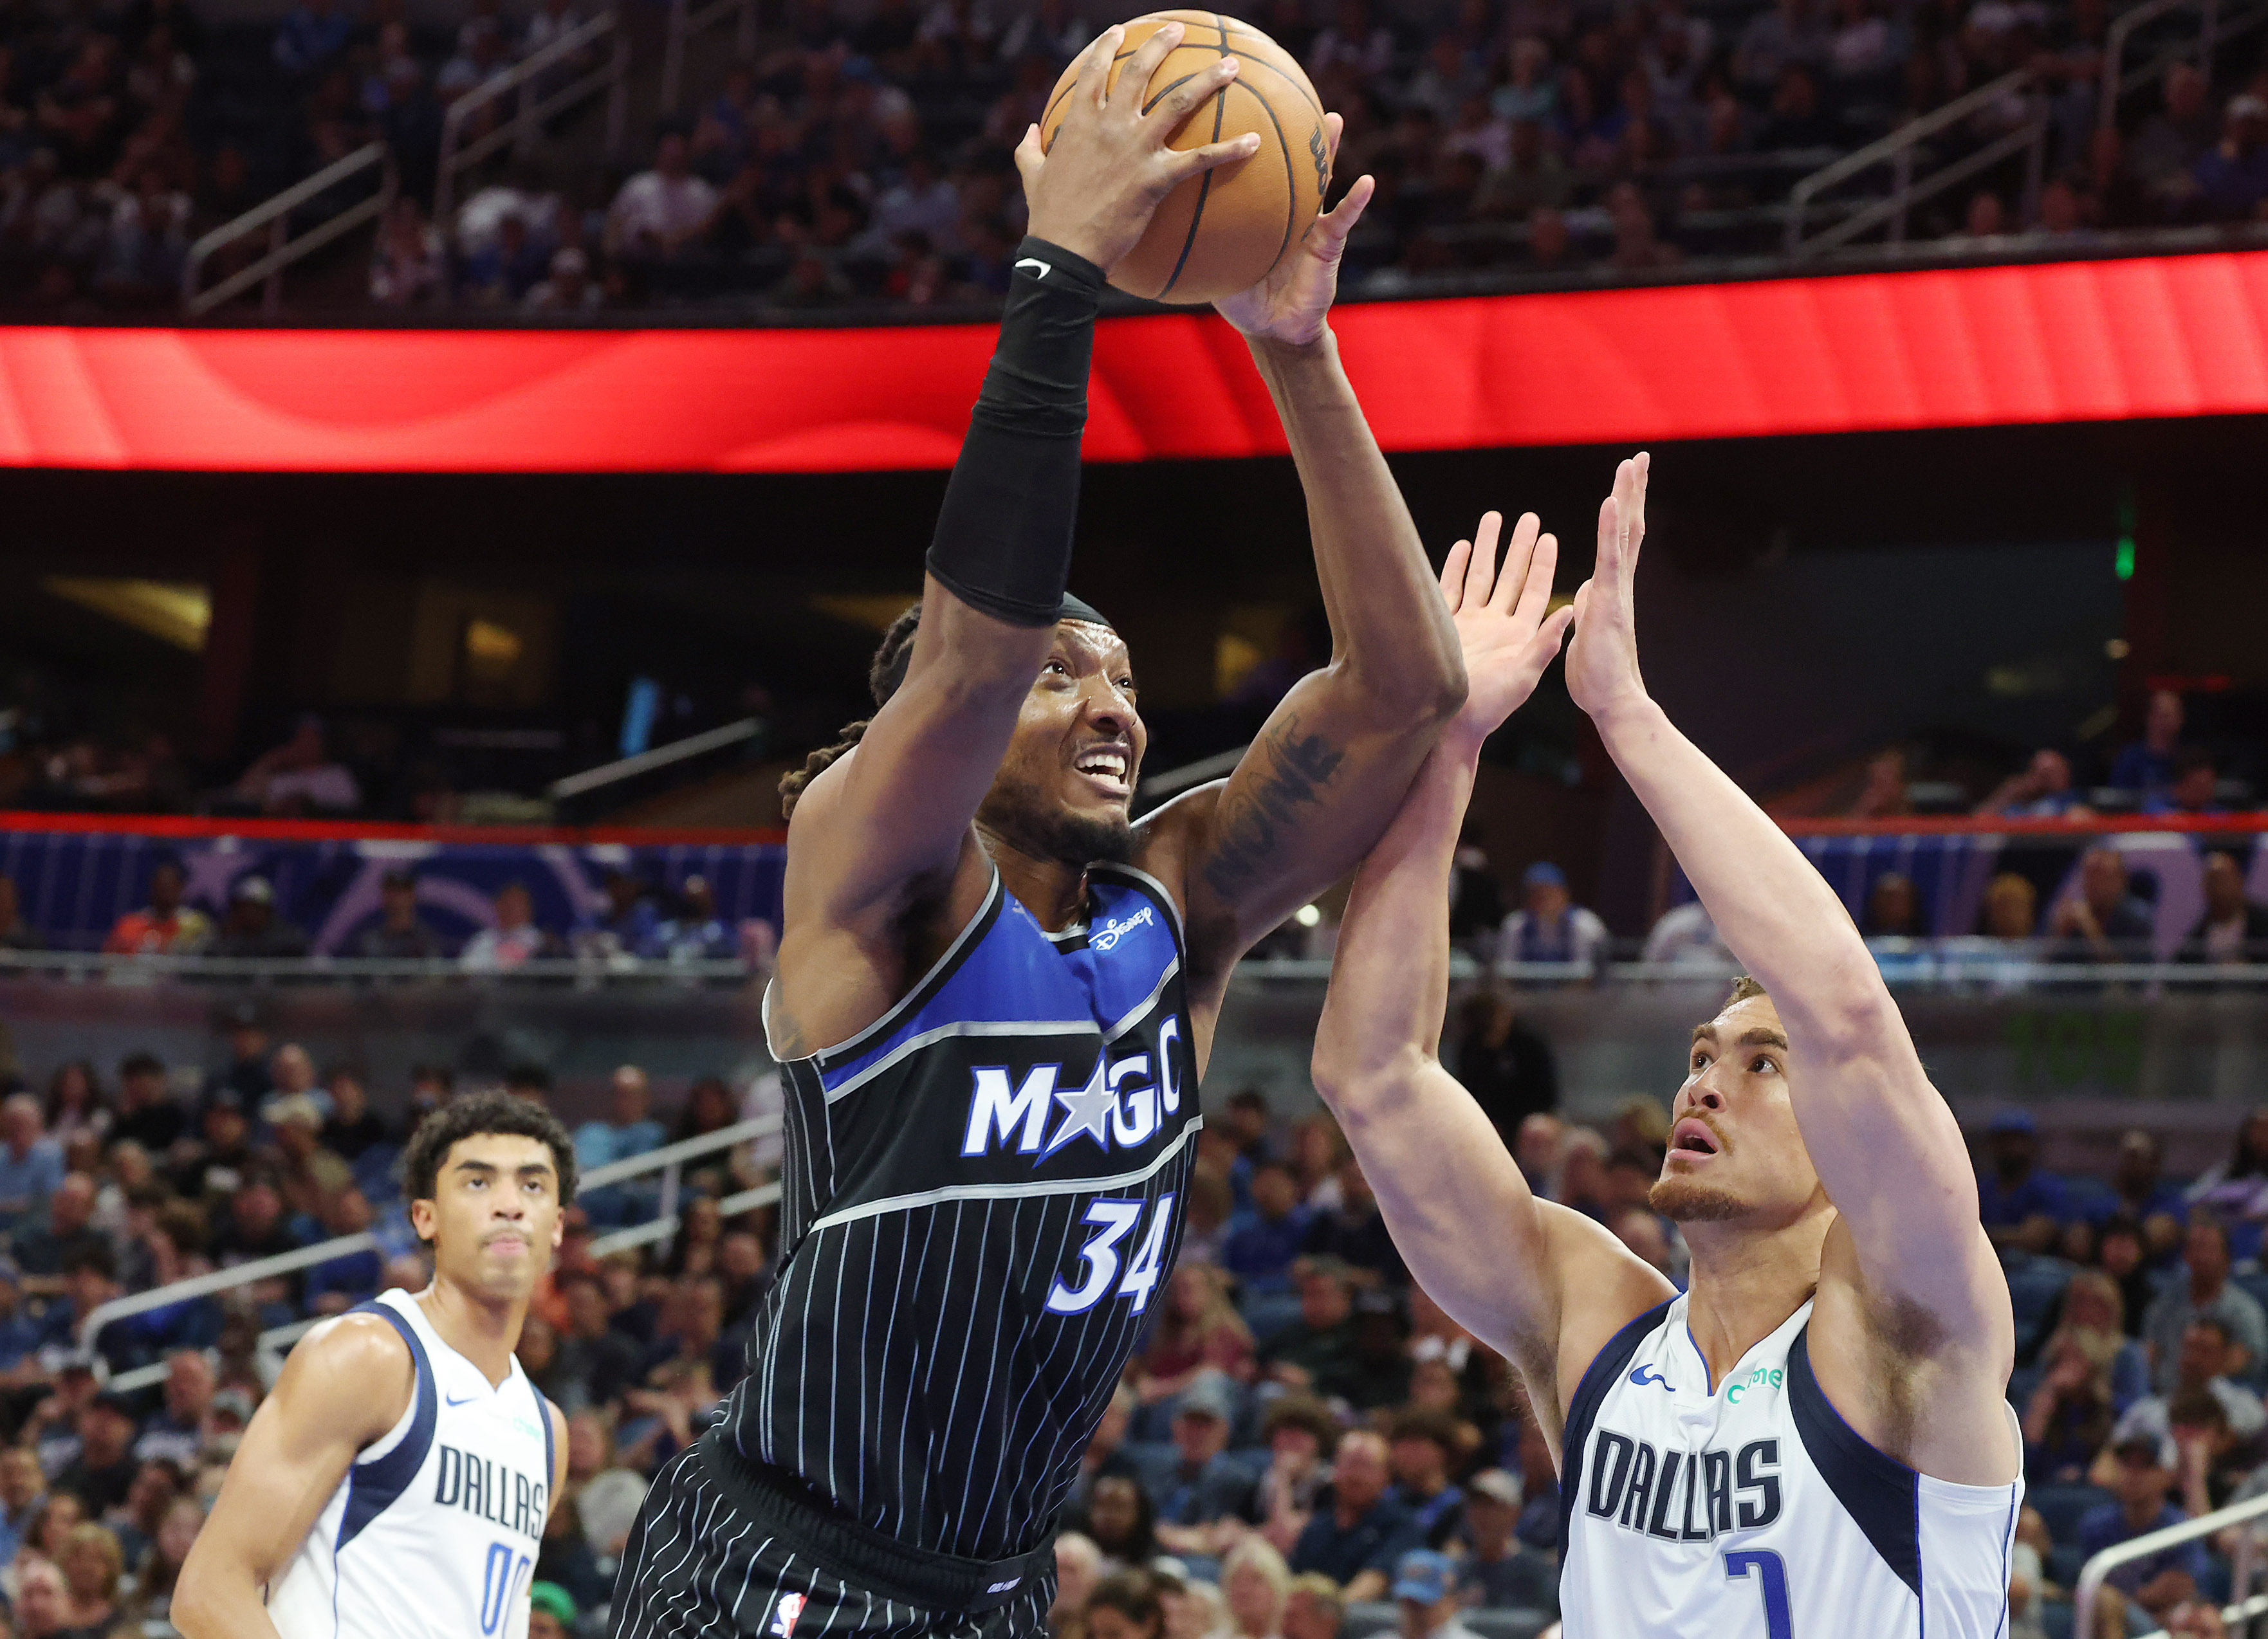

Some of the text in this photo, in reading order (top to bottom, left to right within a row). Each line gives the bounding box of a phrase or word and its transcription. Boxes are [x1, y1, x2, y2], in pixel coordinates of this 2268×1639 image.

[1087, 906, 1154, 951] Disney
[1044, 1191, 1177, 1317] 34
[435, 1443, 543, 1541] DALLAS
[1586, 1426, 1784, 1544] DALLAS
[1720, 1548, 1796, 1639] 7
